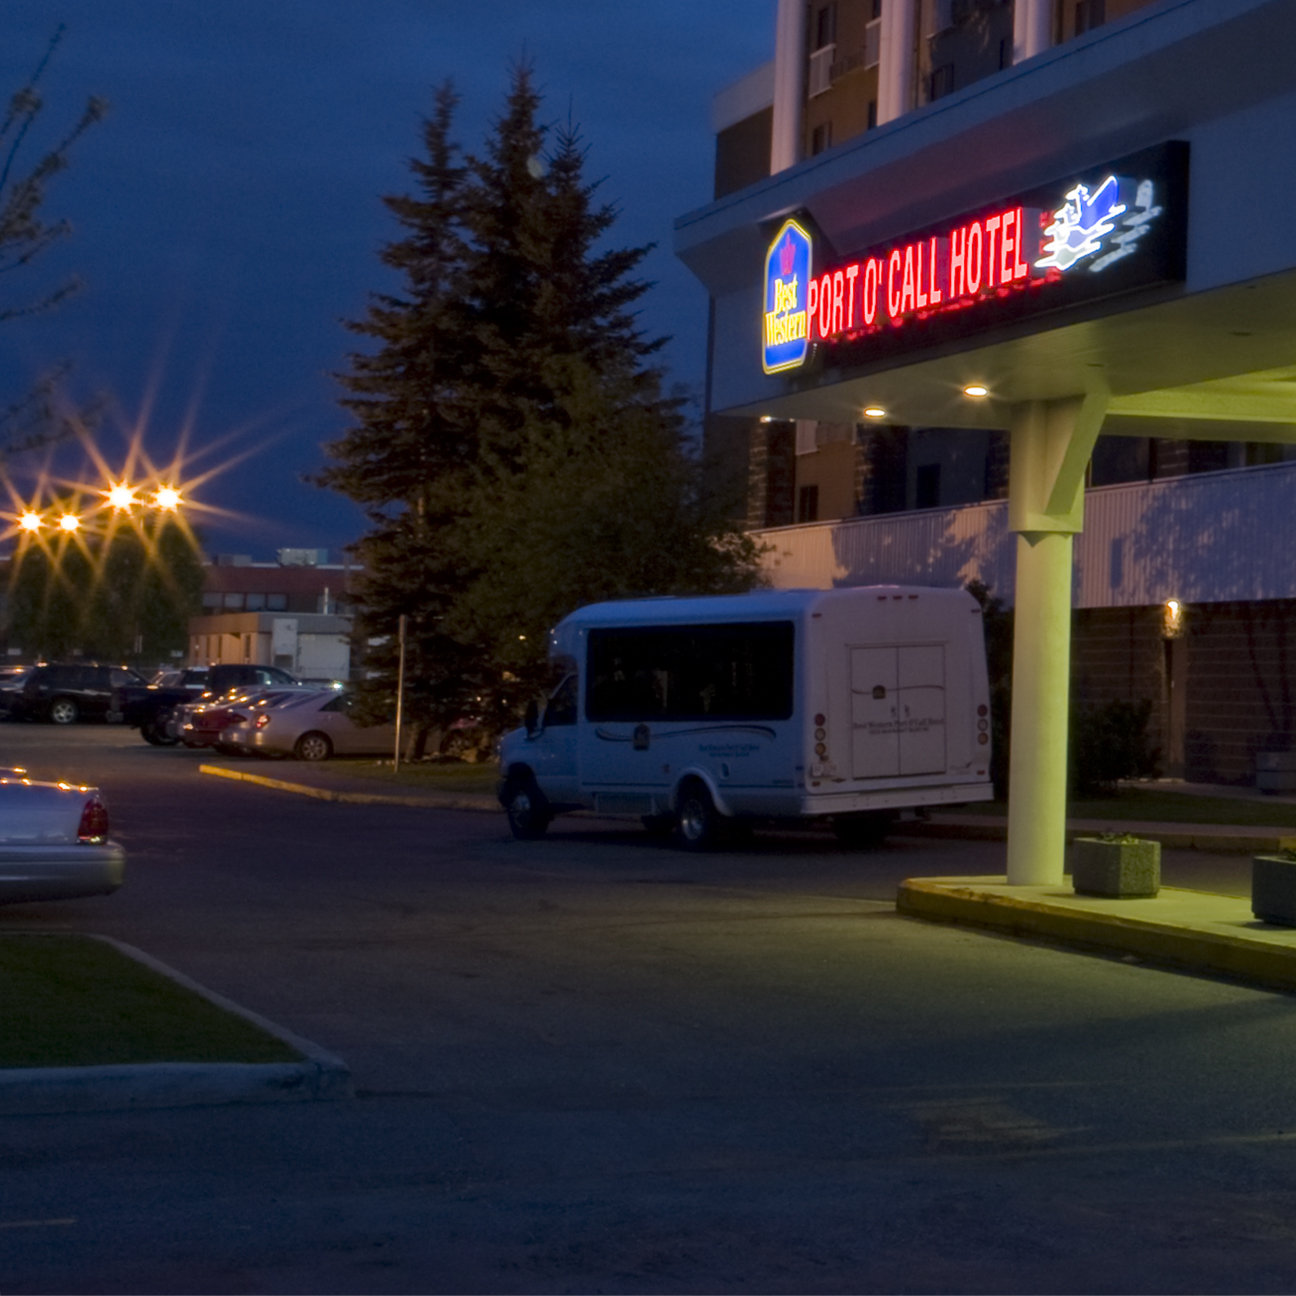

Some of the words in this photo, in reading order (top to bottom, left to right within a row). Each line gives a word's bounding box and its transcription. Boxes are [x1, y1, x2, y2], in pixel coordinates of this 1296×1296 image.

[806, 263, 859, 341] PORT
[886, 236, 941, 319] CALL
[948, 206, 1028, 299] HOTEL
[774, 277, 799, 314] Best
[764, 308, 807, 349] Western
